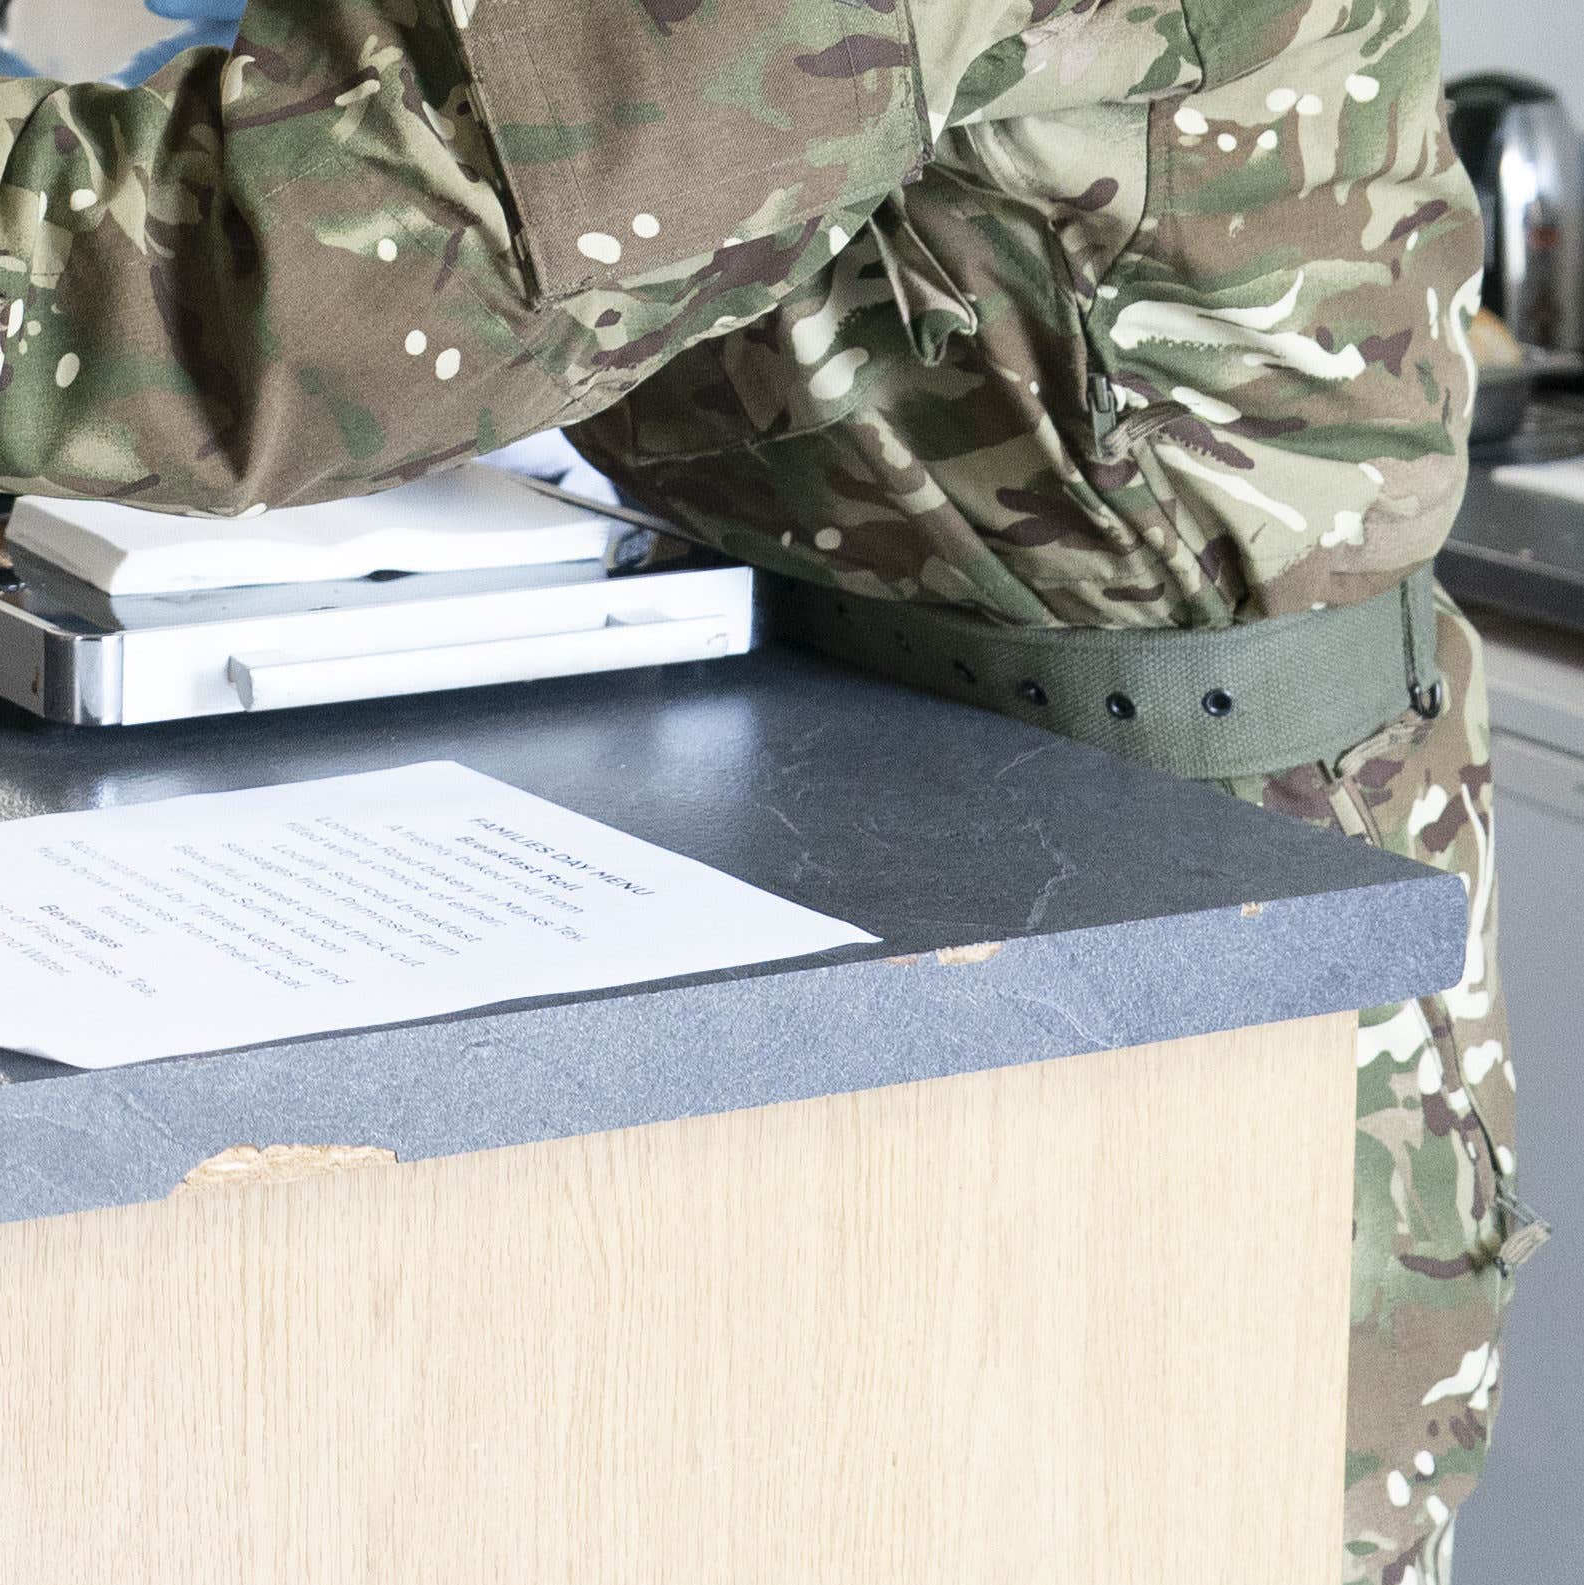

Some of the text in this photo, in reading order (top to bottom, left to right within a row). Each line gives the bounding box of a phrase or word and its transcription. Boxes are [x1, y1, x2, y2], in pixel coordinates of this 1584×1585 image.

[270, 845, 482, 942] Locally sourced breakfast
[284, 822, 327, 842] filled
[322, 841, 360, 858] with
[371, 864, 430, 890] choice
[429, 890, 454, 900] of
[314, 817, 378, 846] London
[379, 846, 426, 865] Road
[420, 866, 475, 892] bakery
[477, 892, 499, 902] in
[498, 901, 555, 926] Marks
[399, 831, 452, 855] freshly
[455, 855, 514, 881] baked
[510, 881, 545, 895] roll
[541, 894, 584, 913] from
[455, 835, 584, 892] Breakfast Roll
[469, 817, 656, 896] FAMILIES DAY MENU
[10, 915, 38, 924] of
[27, 923, 73, 949] Fresh
[39, 904, 123, 949] Beverages
[63, 840, 355, 984] Accompanied by Tiptree ketchup and
[170, 867, 347, 952] smoked Suffolk bacon
[222, 842, 460, 955] sausages from Primrose Farm
[247, 882, 301, 905] sweet
[296, 905, 352, 929] cured
[345, 930, 392, 951] thick
[391, 952, 427, 967] cut
[176, 922, 218, 942] from
[215, 943, 258, 962] their
[254, 963, 311, 989] Local
